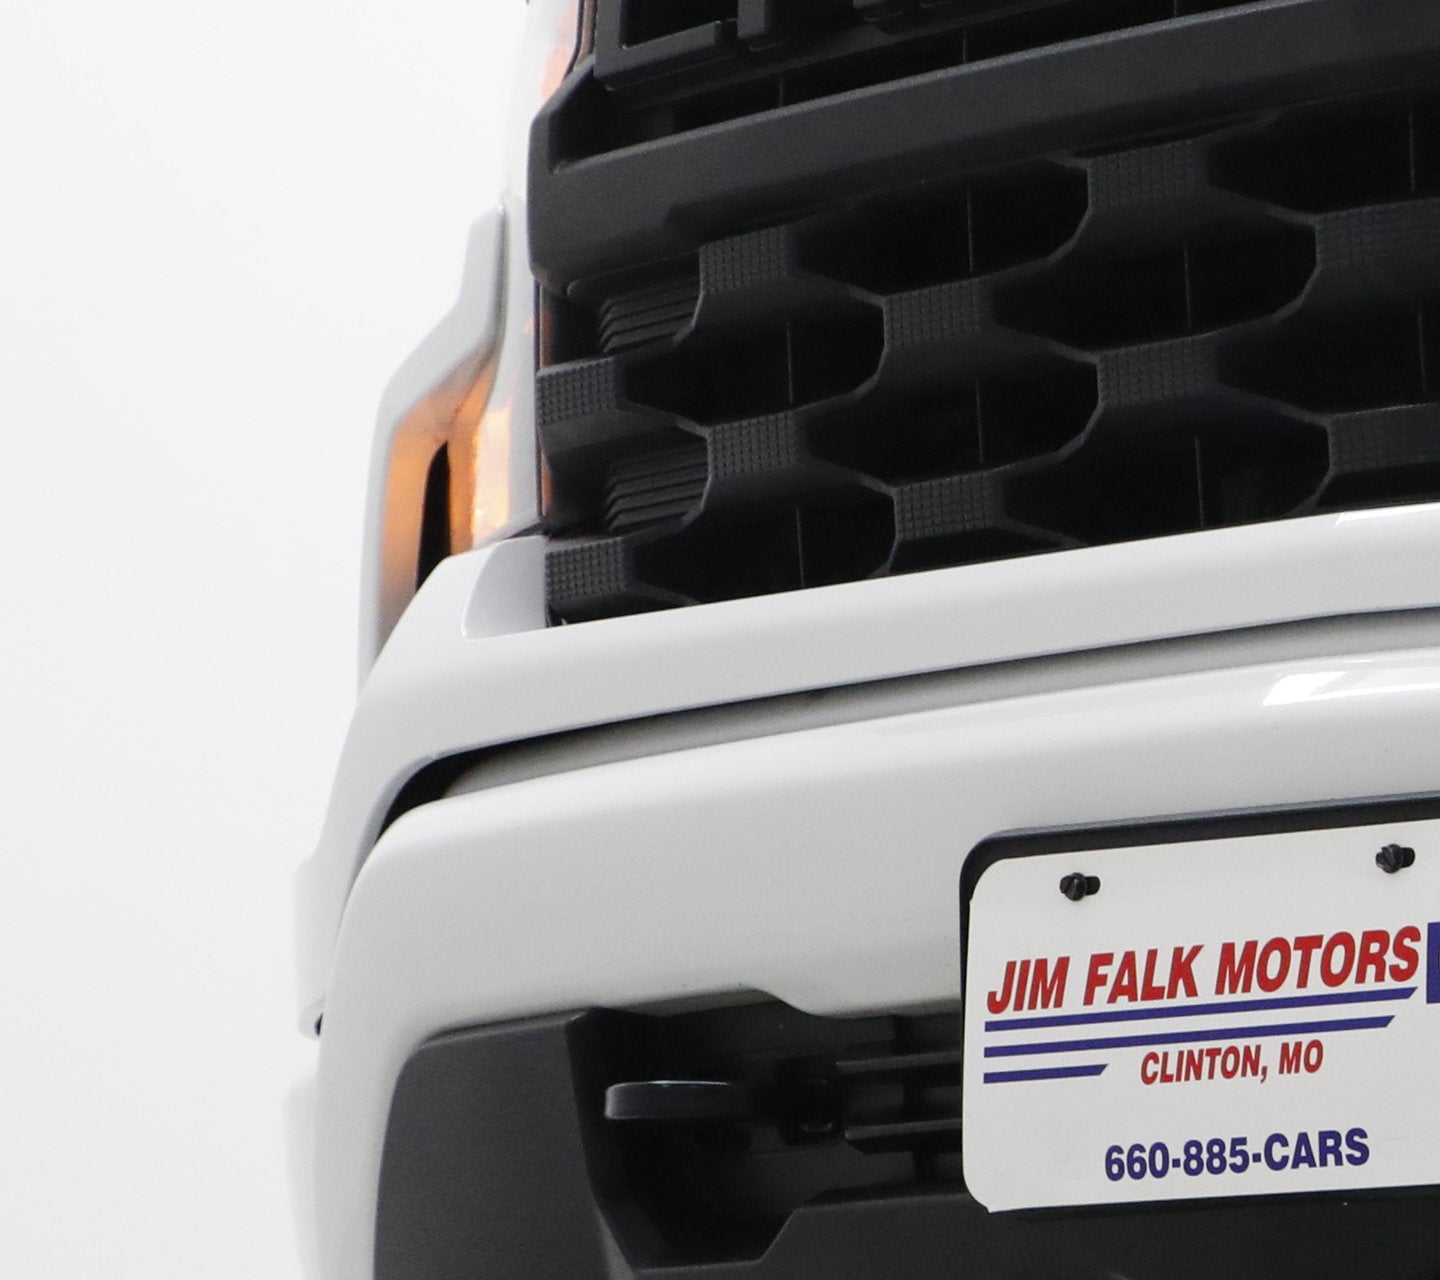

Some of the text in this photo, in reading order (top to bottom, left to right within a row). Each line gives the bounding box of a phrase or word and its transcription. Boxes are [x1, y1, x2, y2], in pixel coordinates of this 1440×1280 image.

[987, 925, 1421, 1015] JIM FALK MOTORS
[1141, 1039, 1324, 1085] CLINTON, MO
[1105, 1127, 1370, 1181] 660-885-CARS
